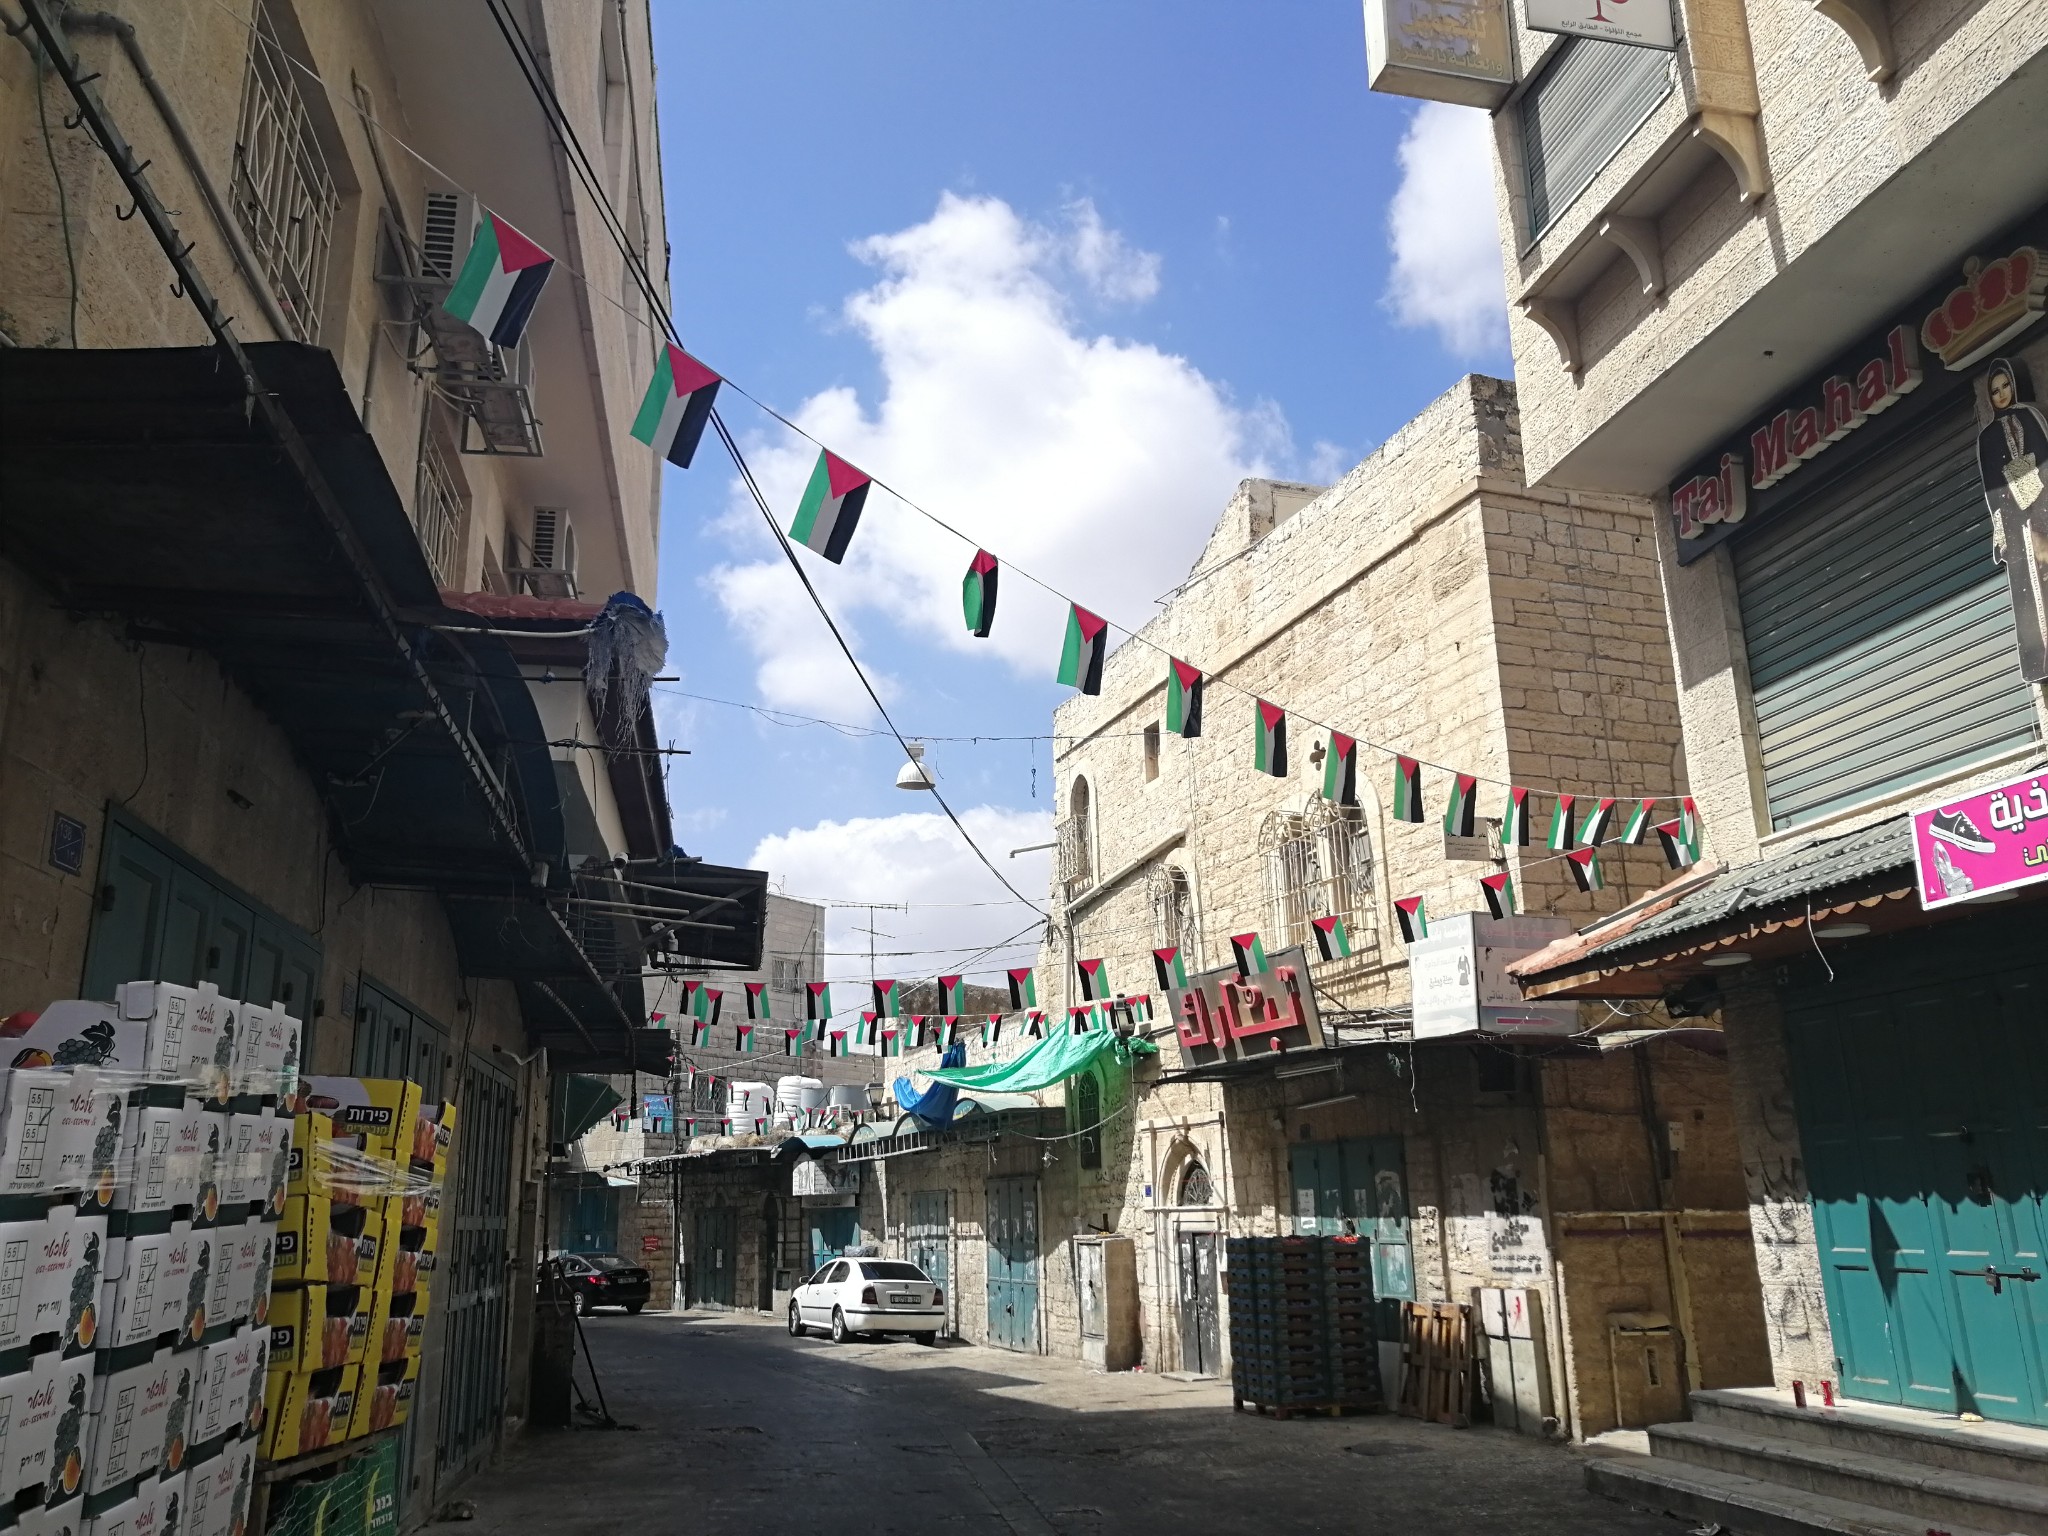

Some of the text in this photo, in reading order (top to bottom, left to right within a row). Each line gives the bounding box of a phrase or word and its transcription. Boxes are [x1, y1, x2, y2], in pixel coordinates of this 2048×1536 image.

[1673, 325, 1919, 539] Taj Mahal
[31, 1093, 42, 1104] 5.5
[347, 1108, 390, 1123] פירות
